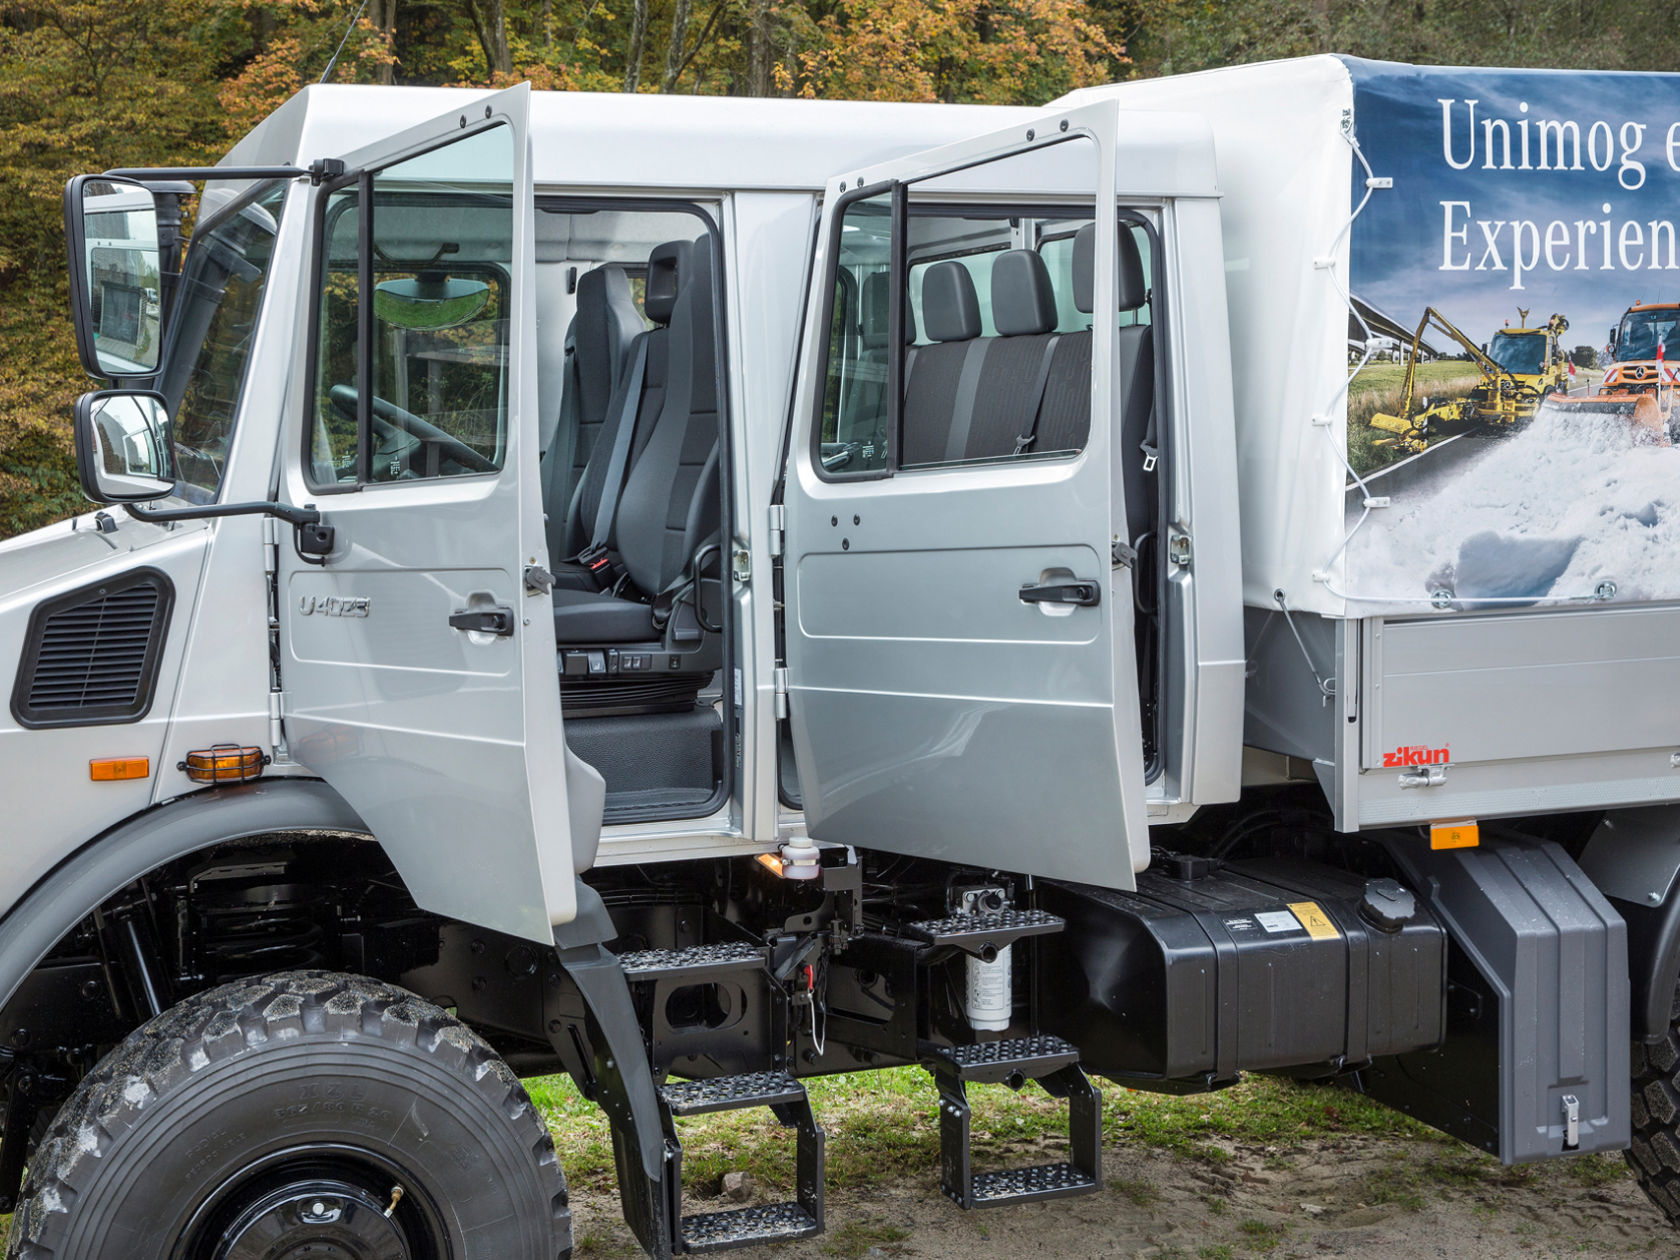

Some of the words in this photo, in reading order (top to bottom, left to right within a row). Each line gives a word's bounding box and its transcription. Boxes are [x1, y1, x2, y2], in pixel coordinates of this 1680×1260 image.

[1437, 98, 1647, 190] Unimog
[1438, 200, 1680, 290] Experien
[1383, 745, 1450, 768] zikun
